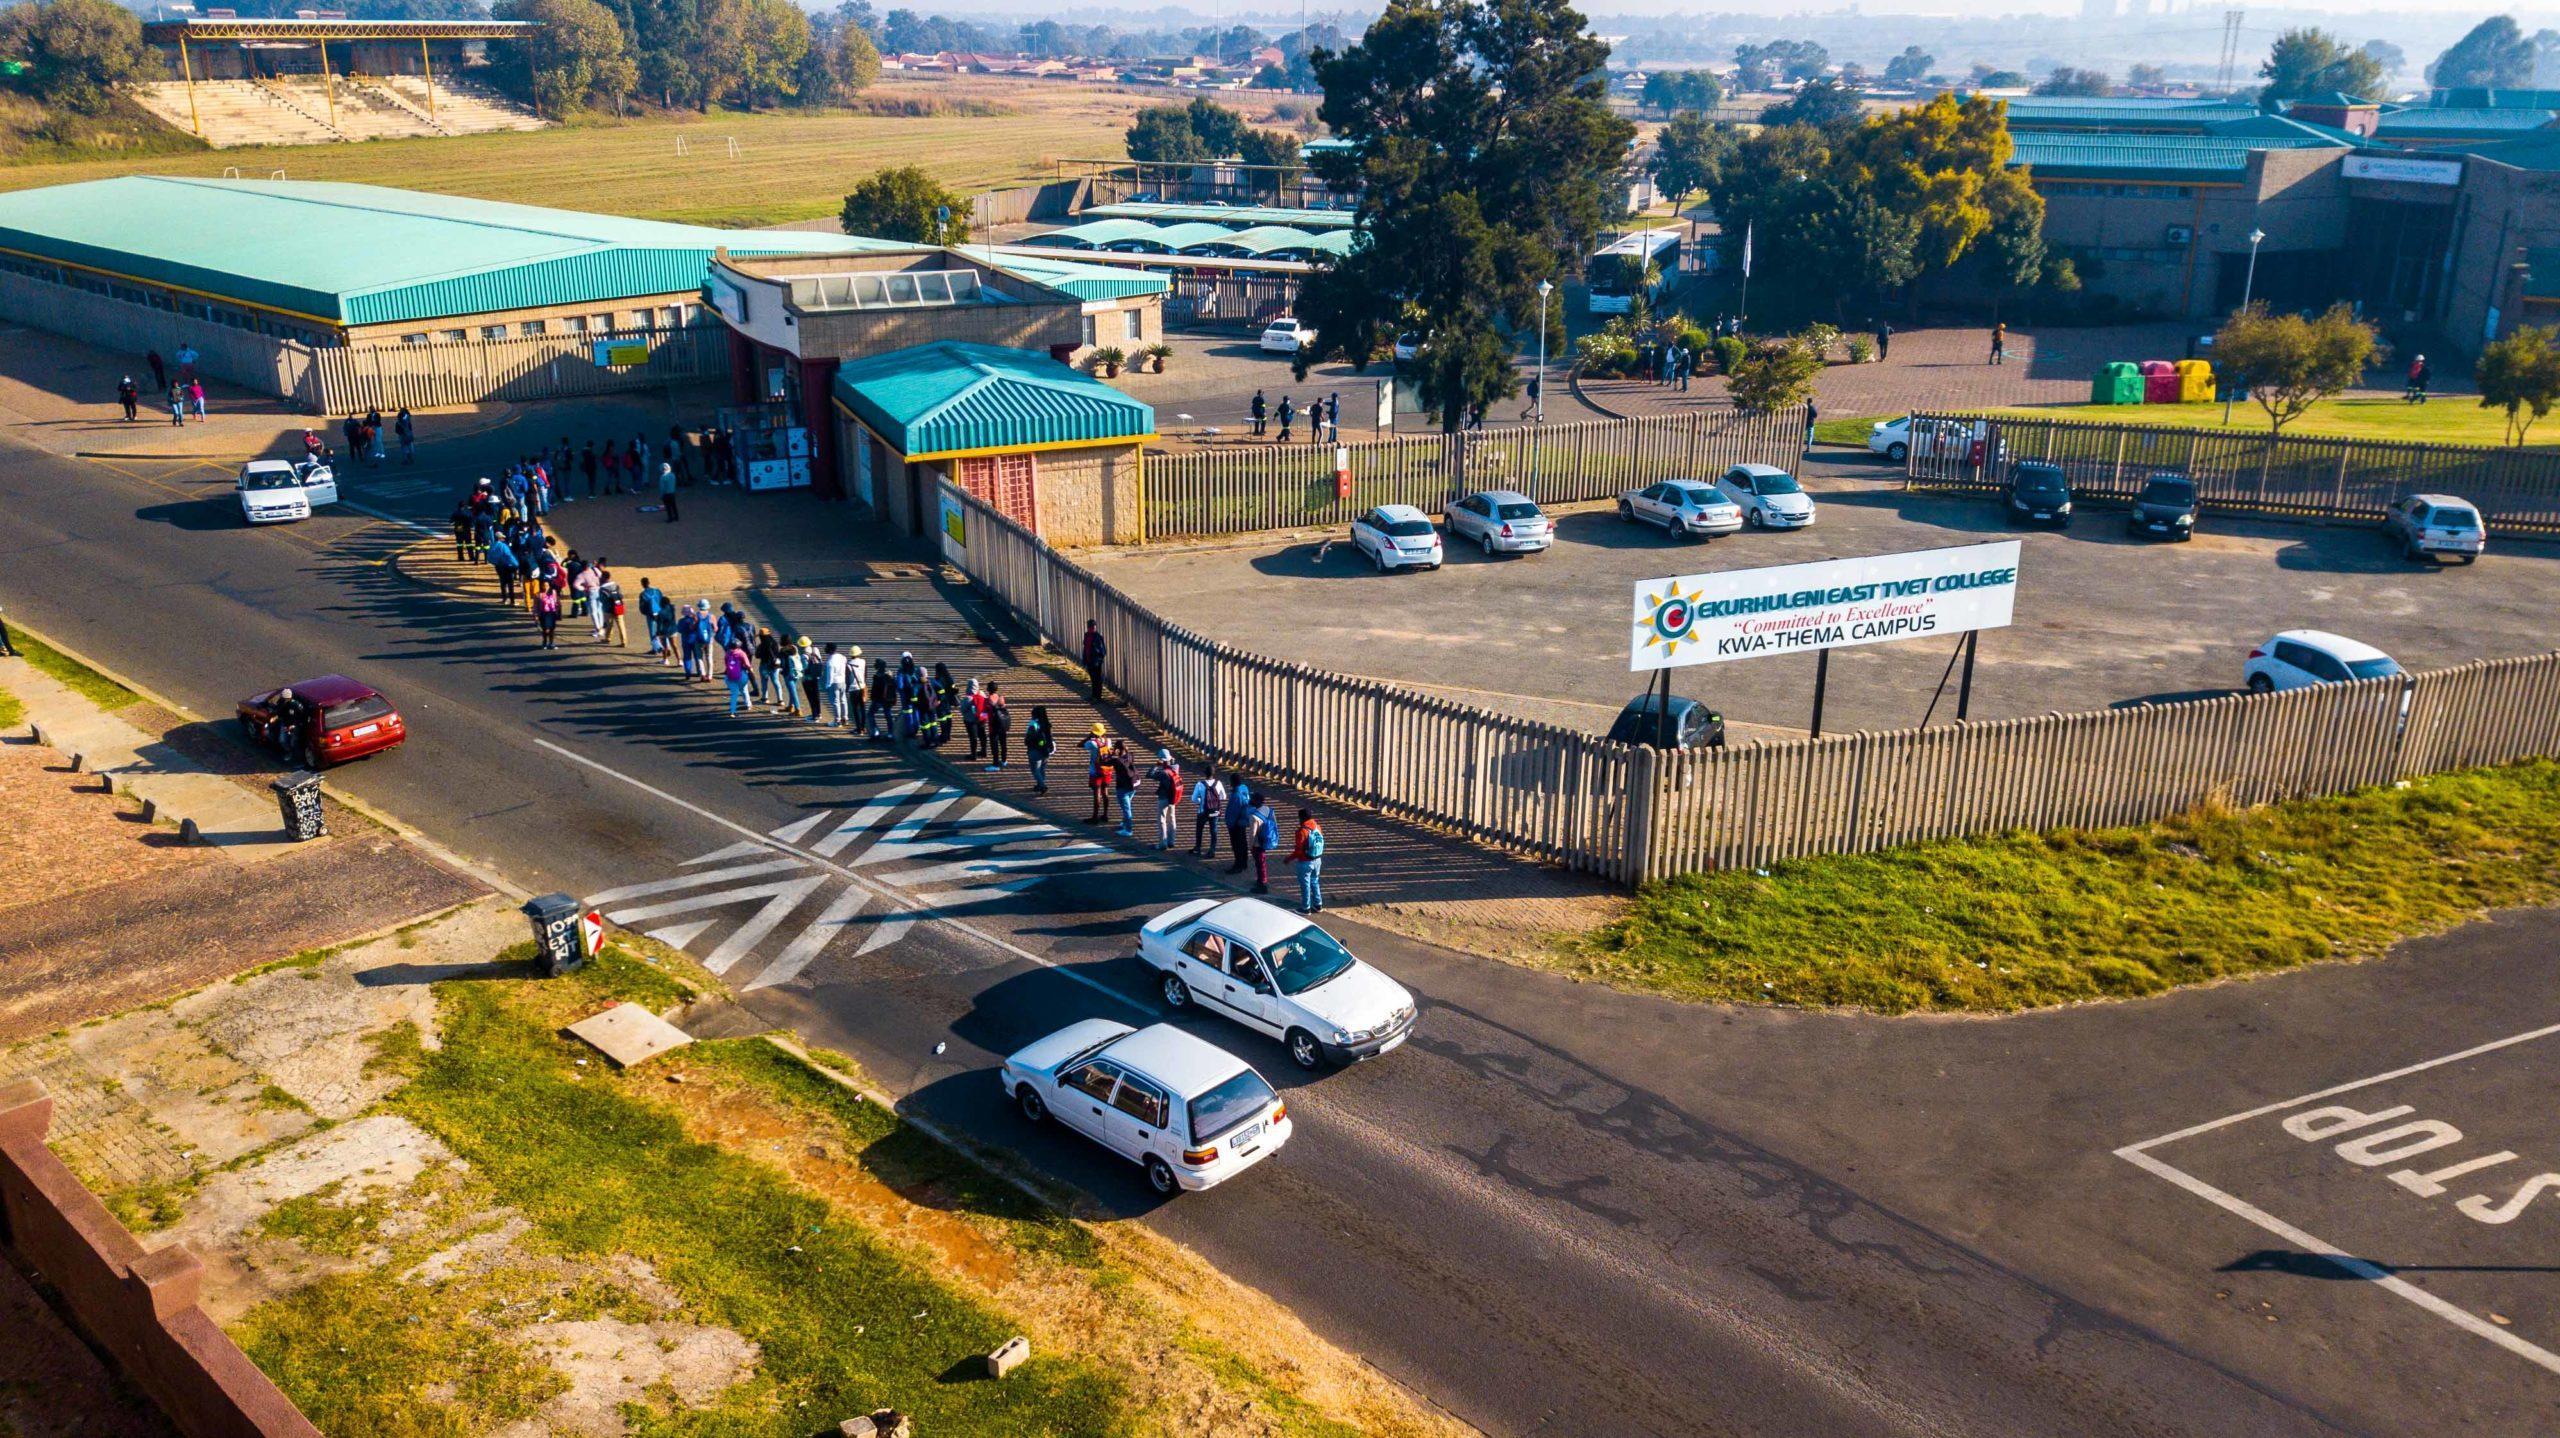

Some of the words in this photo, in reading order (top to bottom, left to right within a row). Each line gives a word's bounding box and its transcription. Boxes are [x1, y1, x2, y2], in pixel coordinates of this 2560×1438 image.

[1697, 589, 1826, 619] EKURHULENI
[1827, 583, 1880, 604] EAST
[1881, 577, 1932, 599] TVET
[1934, 567, 2016, 593] COLLEGE
[1733, 611, 1826, 635] “Committed
[1827, 611, 1842, 625] to
[1845, 598, 1934, 624] Excellence”
[1717, 625, 1845, 656] KWA-THEMA
[1851, 614, 1937, 640] CAMPUS
[2282, 1104, 2560, 1225] STOP
